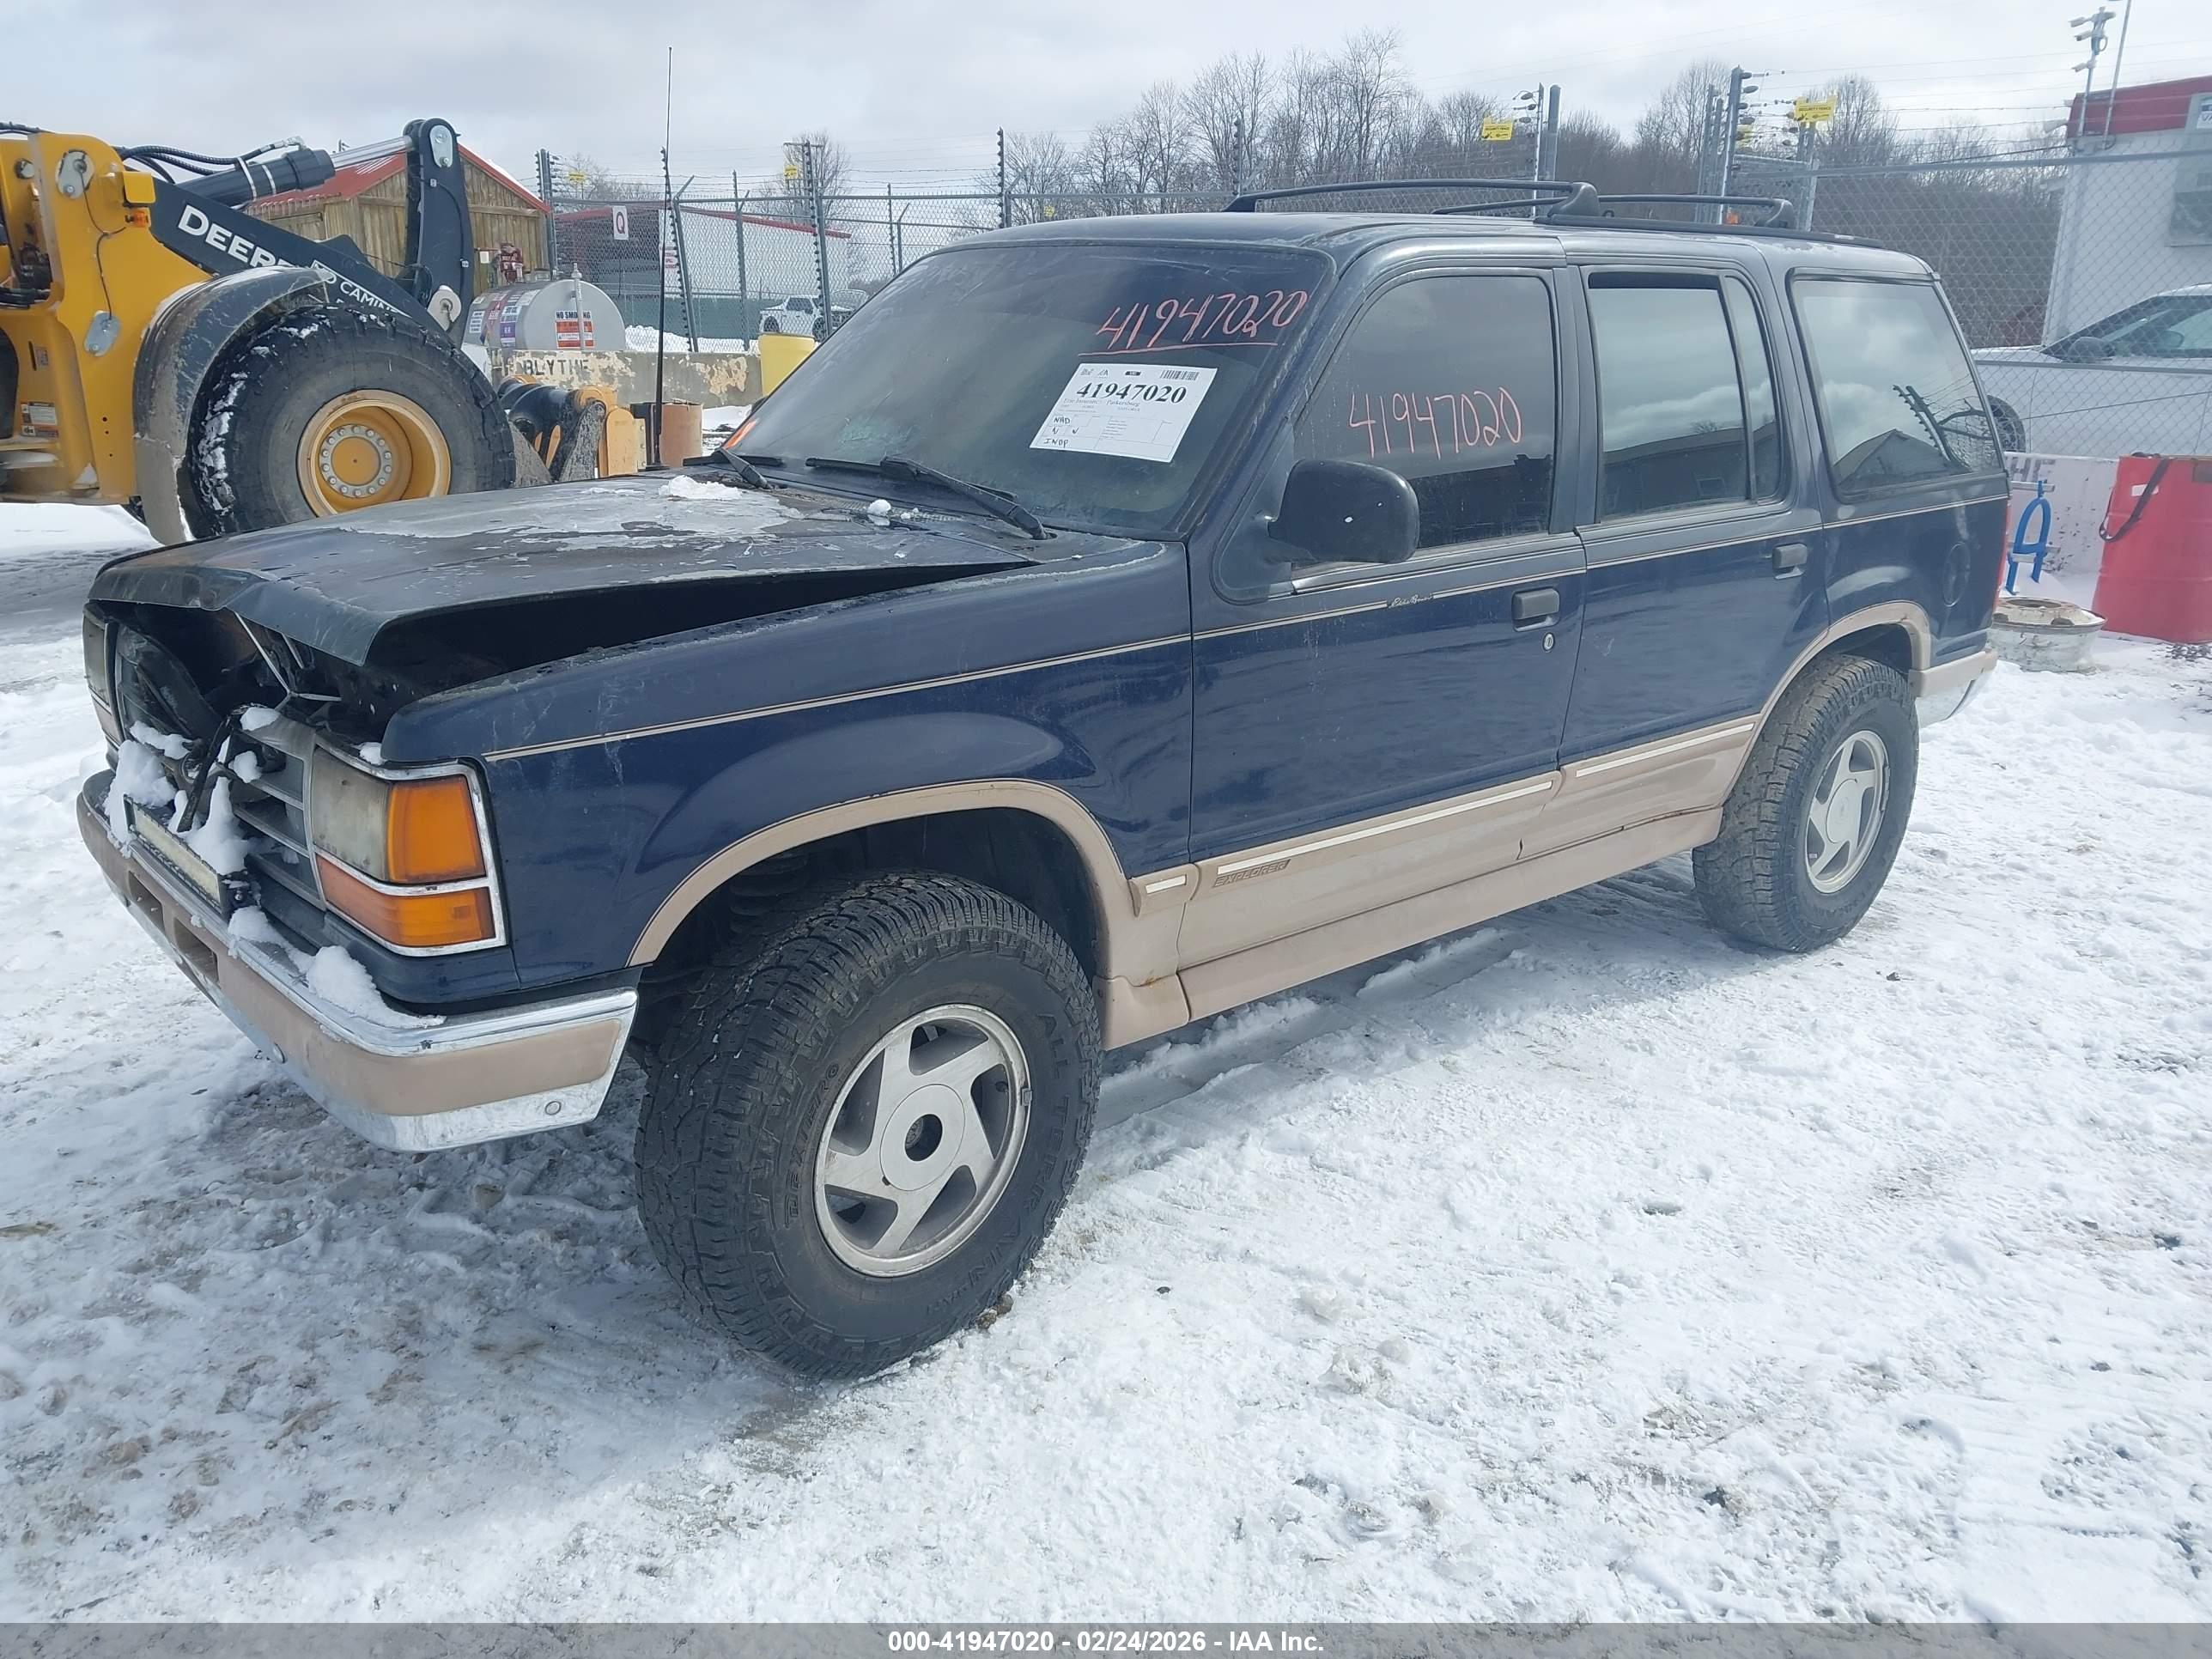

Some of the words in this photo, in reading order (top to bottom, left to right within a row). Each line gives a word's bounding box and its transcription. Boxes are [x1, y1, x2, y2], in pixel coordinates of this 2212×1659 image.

[616, 211, 626, 234] Q
[556, 311, 564, 319] NO
[565, 311, 591, 319] SMONG
[1096, 290, 1308, 349] 41947020
[1076, 382, 1187, 404] 41947020
[1349, 386, 1522, 460] 41947020
[1212, 859, 1291, 888] EXPLORER
